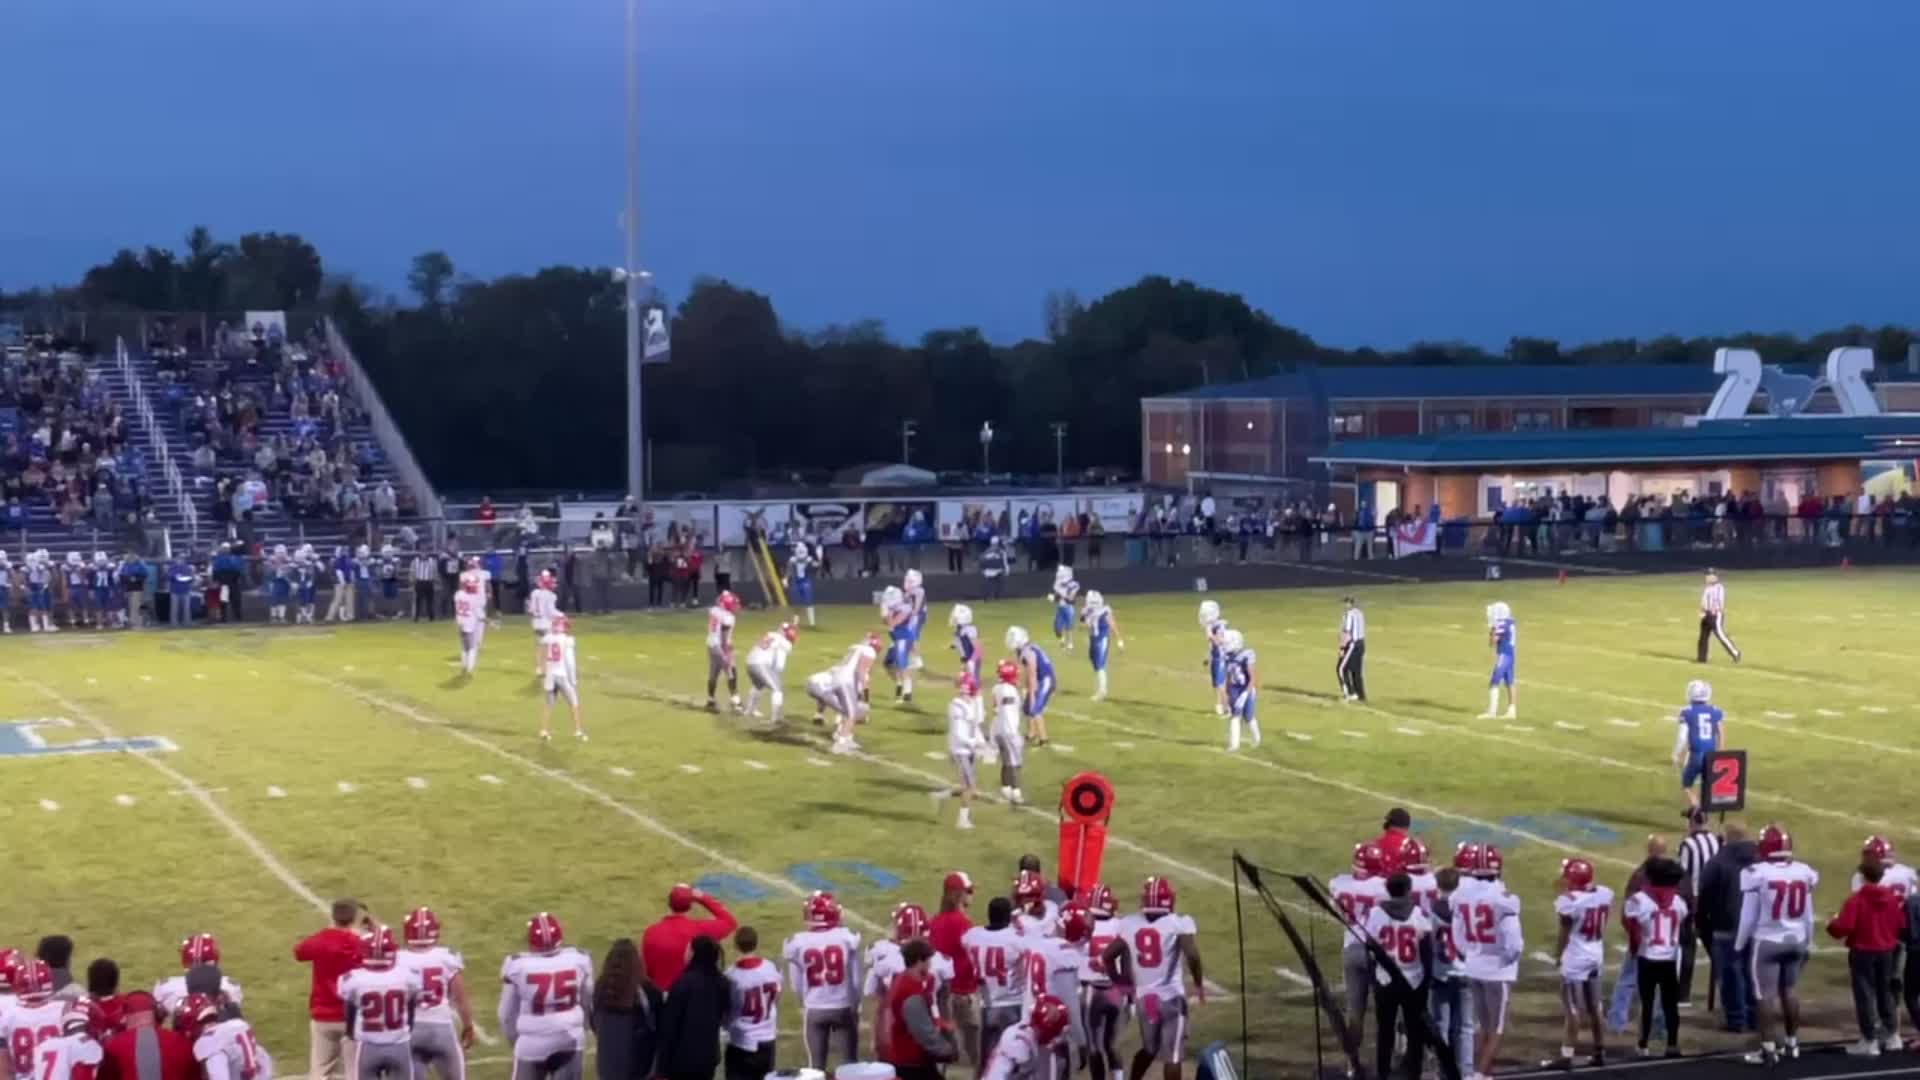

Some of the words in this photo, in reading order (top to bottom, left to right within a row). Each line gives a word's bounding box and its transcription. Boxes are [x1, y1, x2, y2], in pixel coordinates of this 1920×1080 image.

[1711, 756, 1740, 804] 2
[1768, 880, 1807, 920] 70
[1458, 903, 1497, 944] 12
[802, 946, 845, 988] 29
[1135, 928, 1162, 968] 9
[360, 989, 406, 1033] 20
[526, 969, 578, 1016] 75
[740, 982, 778, 1025] 47
